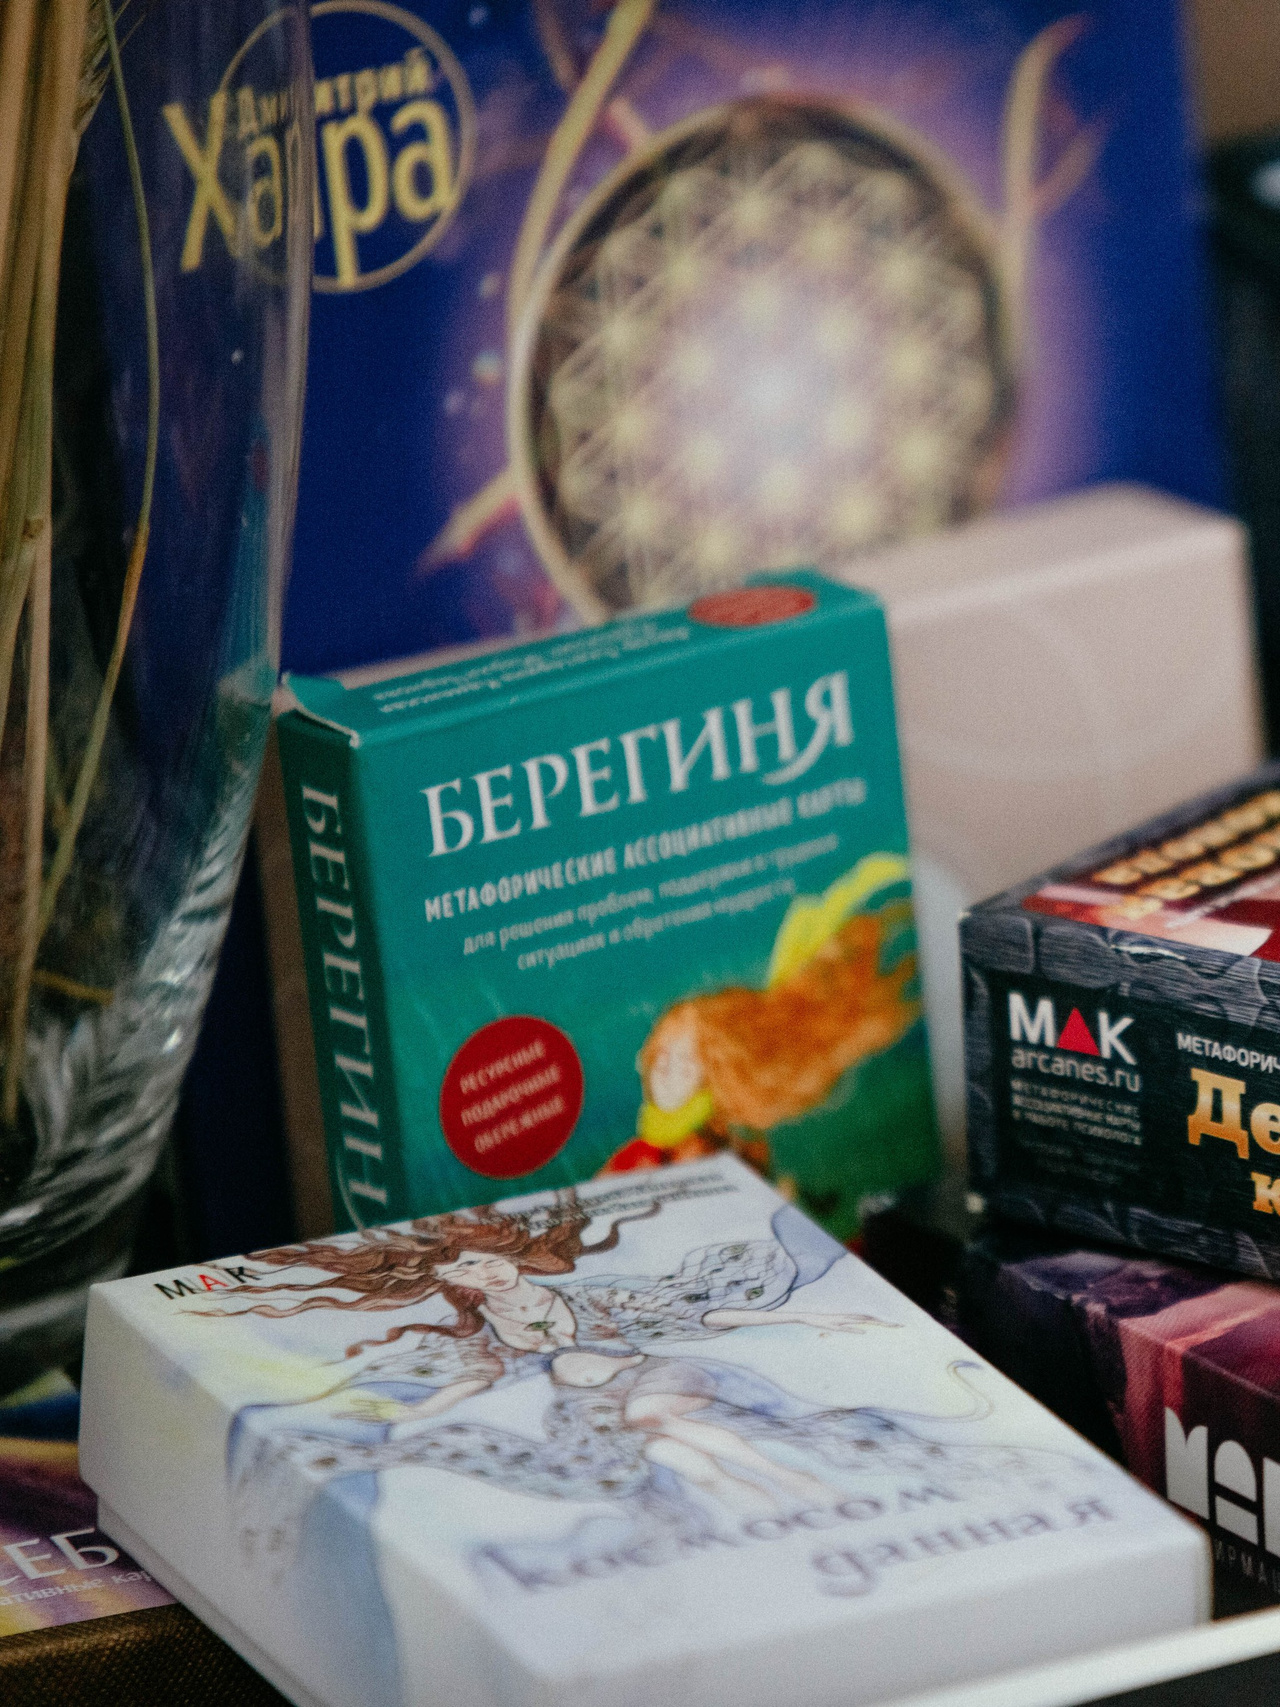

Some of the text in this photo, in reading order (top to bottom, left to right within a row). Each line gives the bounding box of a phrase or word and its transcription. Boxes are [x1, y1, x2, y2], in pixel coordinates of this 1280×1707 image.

[420, 669, 853, 857] БЕРЕГИНЯ
[424, 846, 617, 922] МЕТАФОРИЧЕСКИЕ
[302, 785, 388, 1231] БЕРЕГИН
[1011, 1047, 1142, 1093] arcanes.ru
